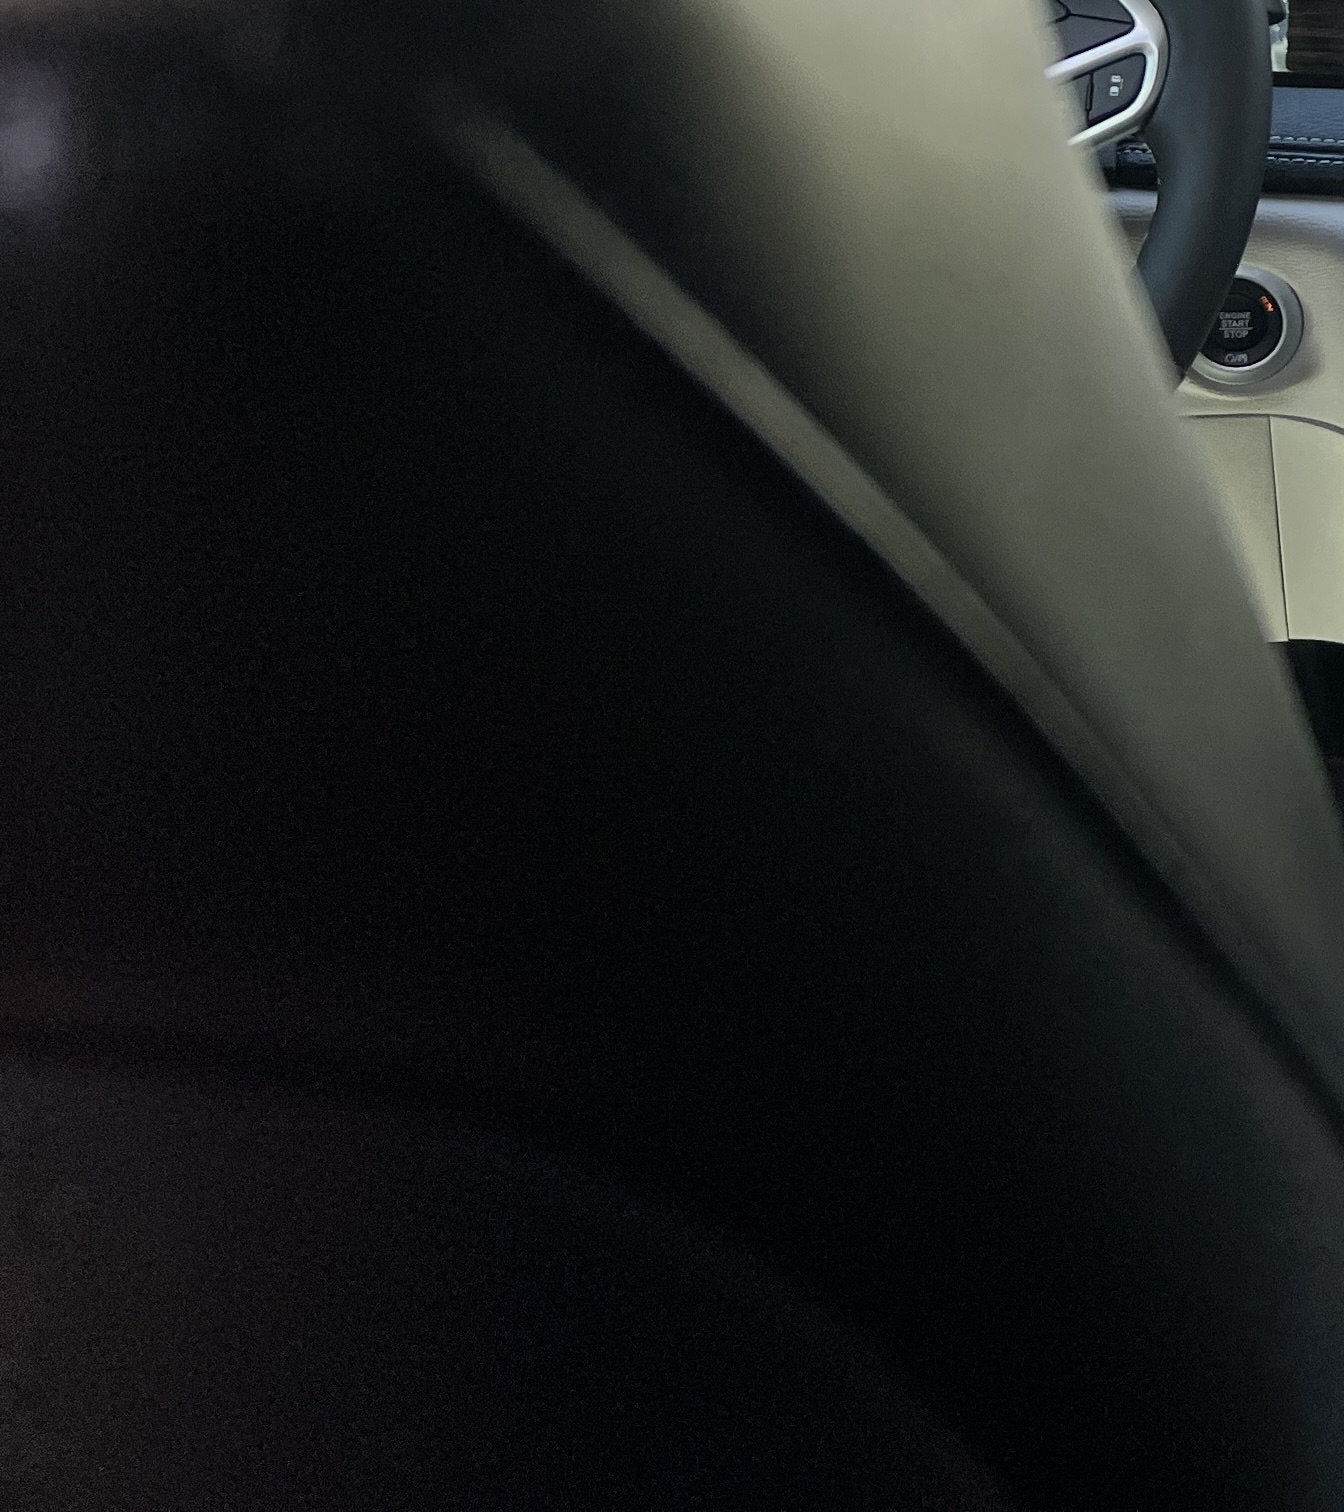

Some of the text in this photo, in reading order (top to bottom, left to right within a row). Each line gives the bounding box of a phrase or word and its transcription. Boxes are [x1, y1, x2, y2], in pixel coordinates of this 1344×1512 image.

[1219, 311, 1251, 319] ENGINE
[1221, 319, 1249, 327] START
[1223, 329, 1248, 339] STOP
